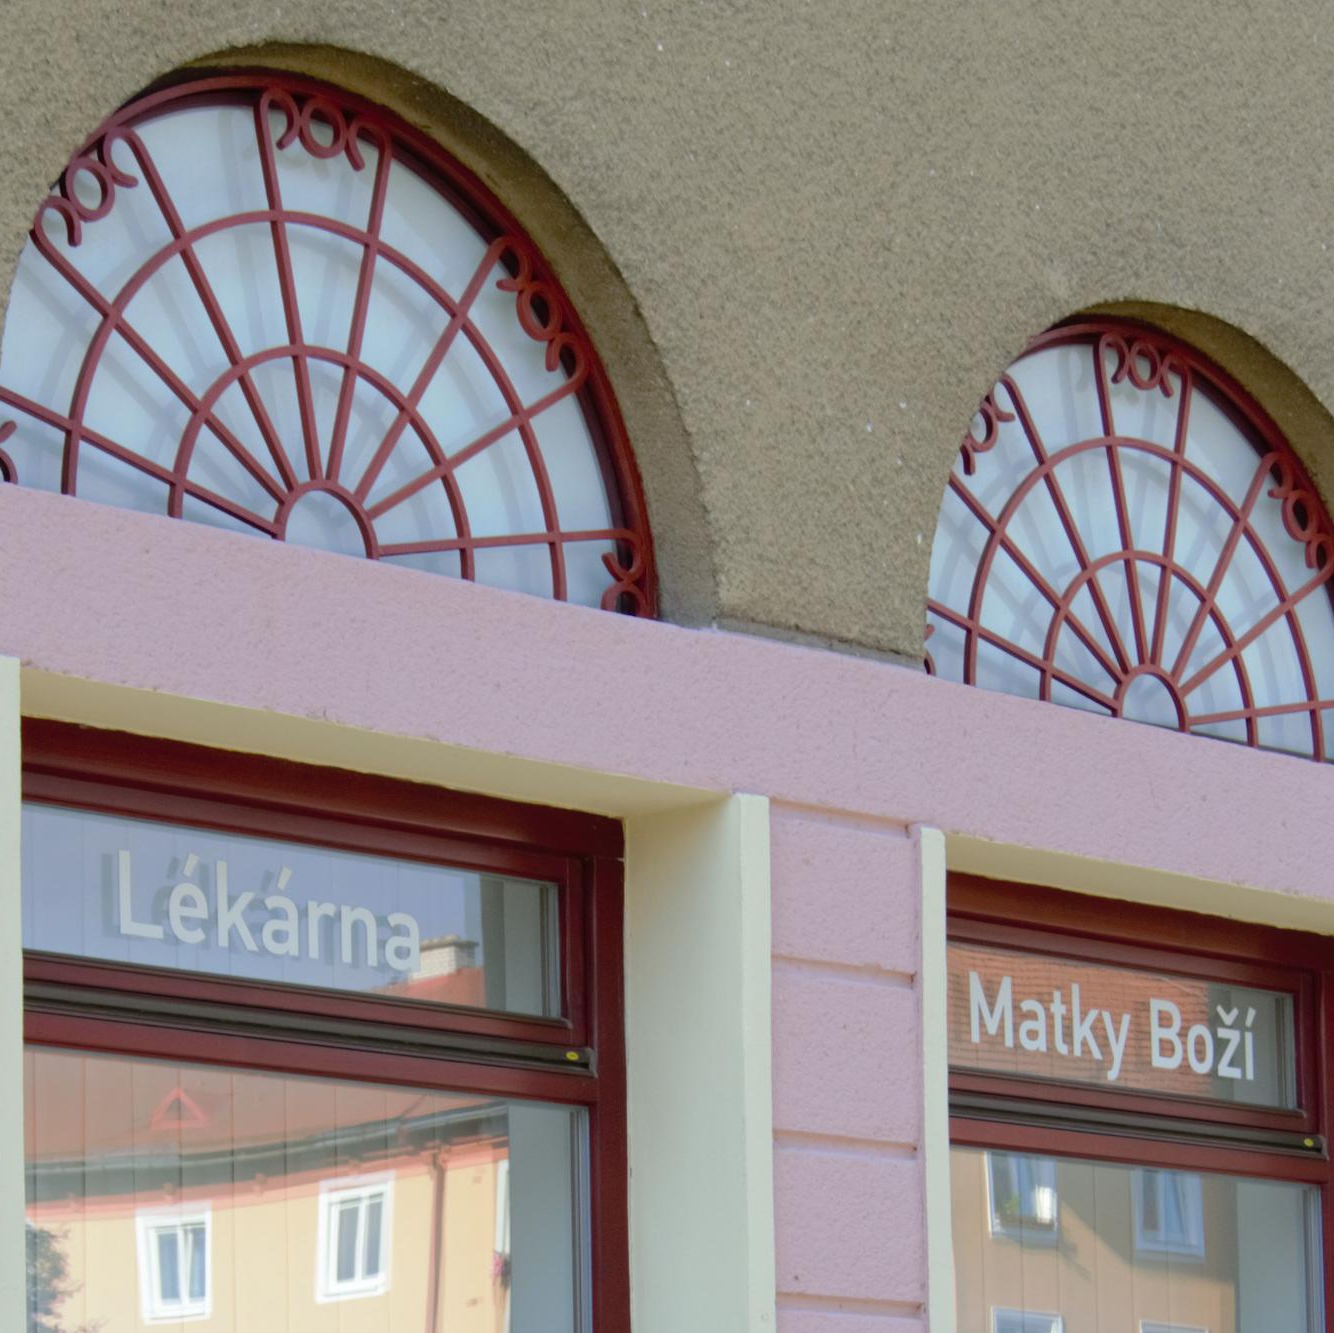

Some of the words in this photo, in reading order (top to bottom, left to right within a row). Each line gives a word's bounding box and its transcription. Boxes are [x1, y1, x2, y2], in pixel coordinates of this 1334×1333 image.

[118, 849, 422, 972] Lékárna
[969, 970, 1131, 1081] Matky
[1149, 997, 1257, 1081] Boží
